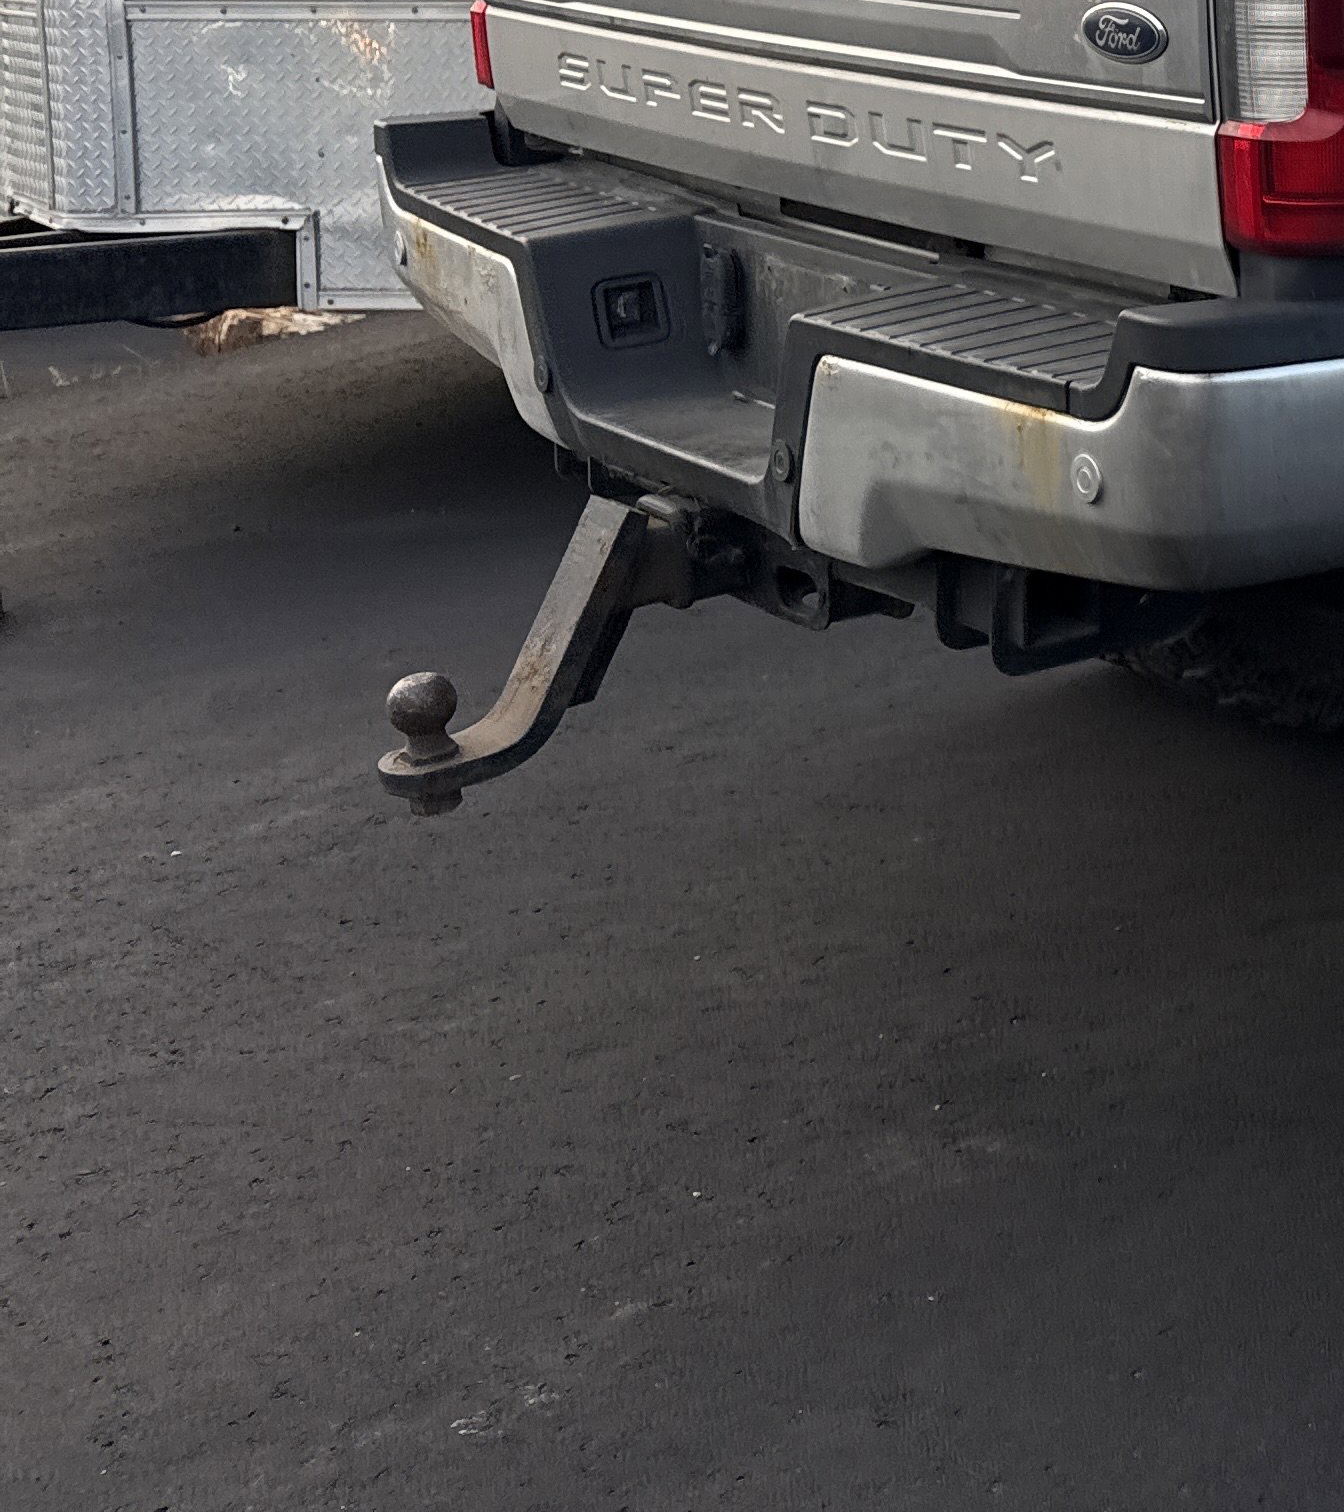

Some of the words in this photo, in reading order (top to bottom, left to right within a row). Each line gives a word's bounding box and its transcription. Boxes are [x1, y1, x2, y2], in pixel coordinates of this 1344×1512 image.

[1094, 13, 1142, 51] Ford
[557, 50, 787, 135] SUPER
[805, 99, 1060, 184] DUTY
